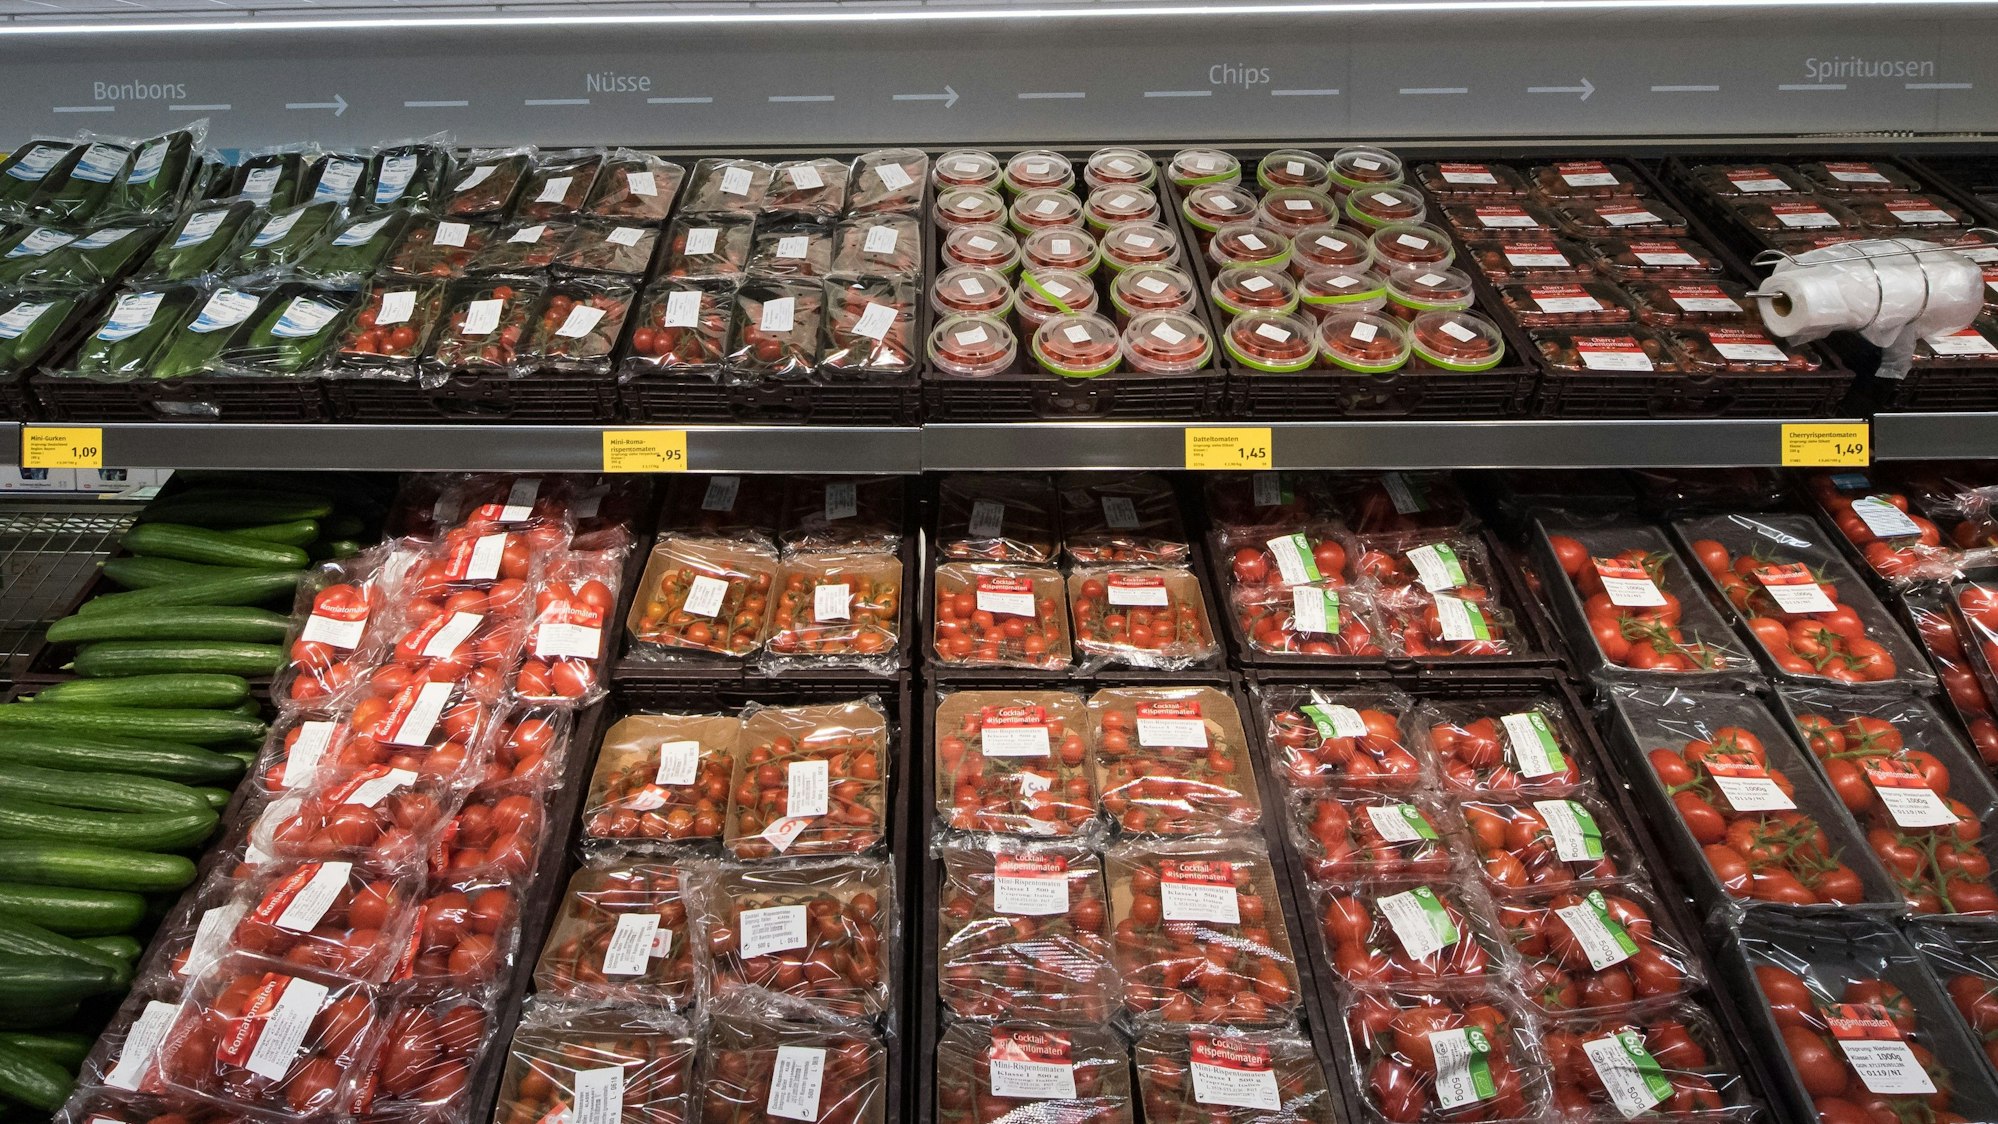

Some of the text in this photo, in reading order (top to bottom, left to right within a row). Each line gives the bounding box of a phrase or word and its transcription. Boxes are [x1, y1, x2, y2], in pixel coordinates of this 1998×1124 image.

[1210, 63, 1270, 89] Chips
[1806, 56, 1934, 83] Spirituosen
[94, 80, 186, 100] Bonbons
[587, 72, 651, 92] Nüsse
[72, 446, 97, 459] 1,09
[656, 450, 682, 462] -,95
[1238, 448, 1266, 460] 1,45
[1834, 444, 1863, 456] 1,49
[380, 685, 414, 736] Romatomaten
[1002, 862, 1060, 872] Rispentomaten
[1180, 864, 1212, 872] Cocktail-
[1167, 872, 1226, 881] Rispentomaten
[261, 868, 310, 916] Romatomaten
[1588, 892, 1606, 910] bio
[1415, 930, 1430, 952] 500g
[1598, 940, 1614, 962] 500g
[228, 980, 277, 1056] Romatomaten
[1828, 1017, 1892, 1030] Rispentomaten
[1014, 1032, 1048, 1044] Cocktail-
[1212, 1038, 1247, 1052] Cocktail-
[1470, 1030, 1488, 1052] bio
[1625, 1036, 1644, 1056] bio
[1197, 1046, 1262, 1064] Rispentomaten
[1876, 1052, 1902, 1062] 1000g
[994, 1060, 1064, 1072] Mini-Rispentomaten
[1194, 1063, 1266, 1078] Mini-Rispentomaten
[1452, 1077, 1464, 1102] 500g
[1627, 1086, 1646, 1110] 500g
